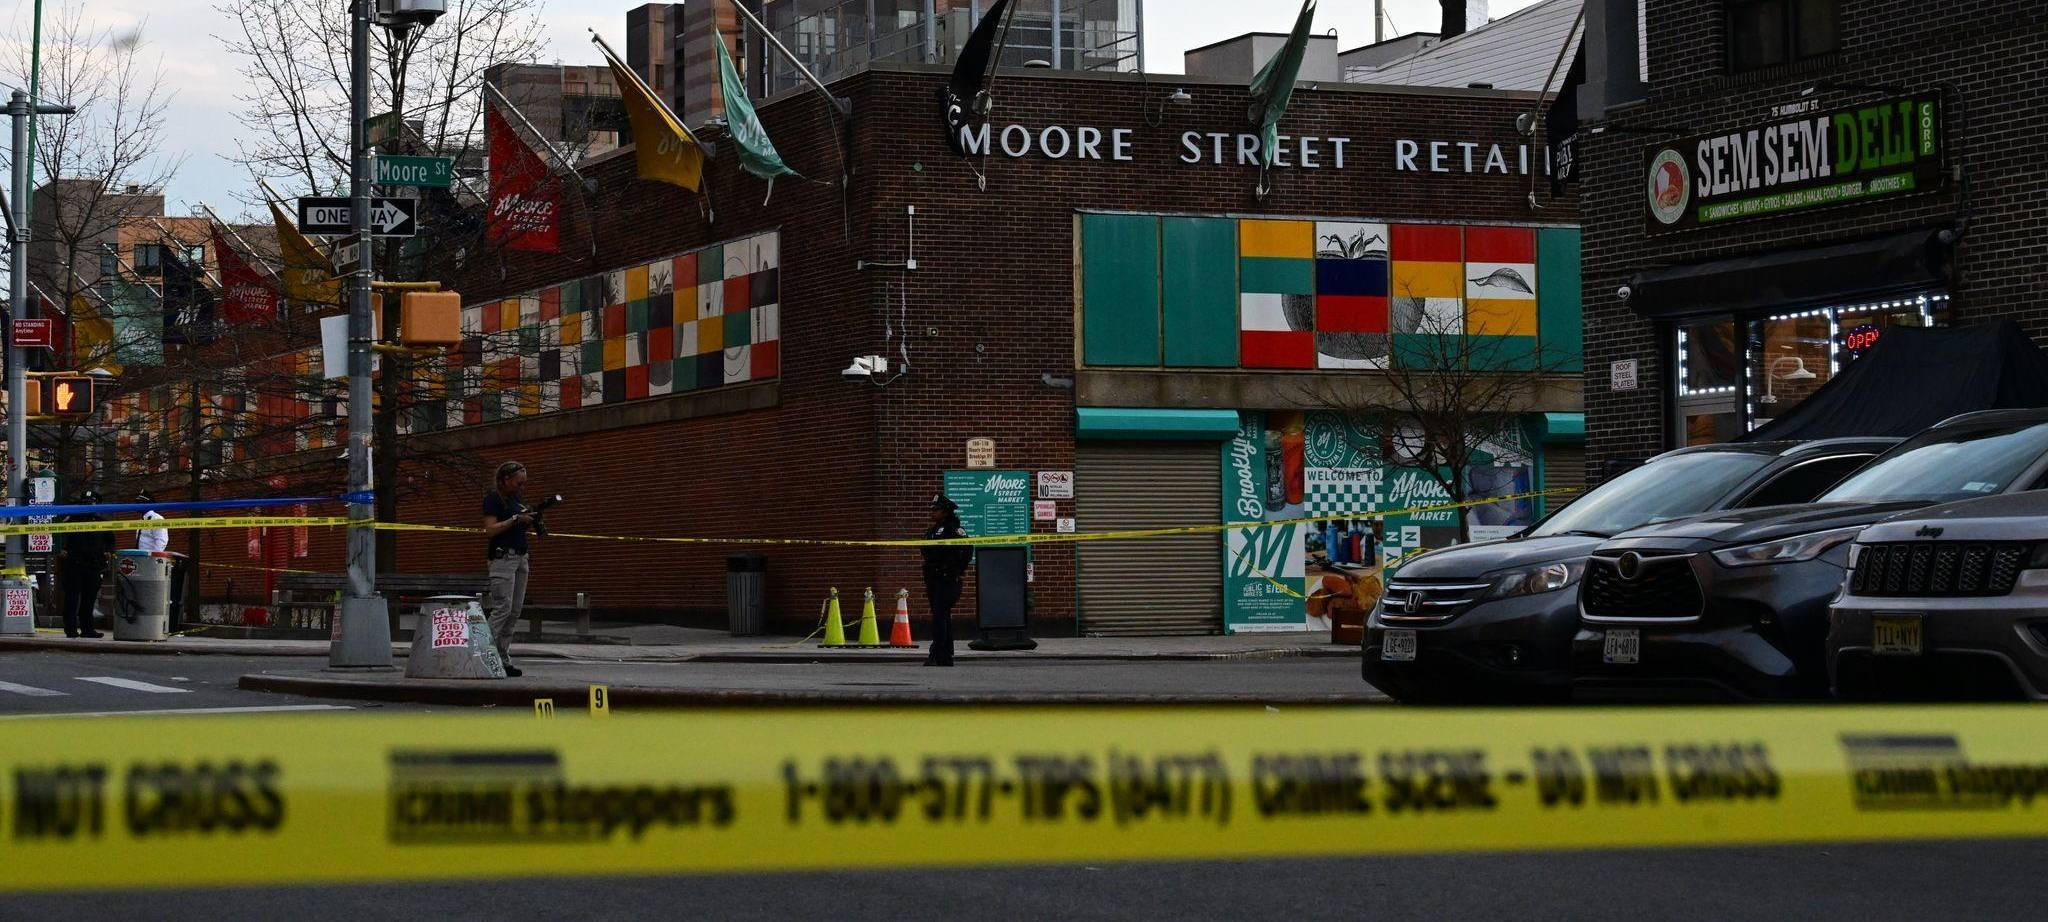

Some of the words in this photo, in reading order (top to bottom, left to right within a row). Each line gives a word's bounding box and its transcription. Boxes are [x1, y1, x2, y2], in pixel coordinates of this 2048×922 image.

[1922, 104, 1933, 153] CORP
[960, 122, 1133, 160] MOORE
[1180, 131, 1350, 168] STREET
[1697, 129, 1760, 198] SEM
[1764, 116, 1831, 186] SEM
[1834, 100, 1916, 175] DELI
[379, 159, 428, 182] Moore
[435, 162, 446, 175] St
[1709, 203, 1740, 218] SANDWICHES
[1785, 192, 1803, 206] SALADS
[1870, 177, 1900, 193] SMOOTHIES
[316, 209, 350, 224] ONE
[1848, 331, 1880, 349] OPEN
[1615, 371, 1632, 379] STEEL
[1616, 363, 1631, 371] ROOF
[1614, 379, 1634, 388] PLATED
[984, 474, 1026, 496] MOORE
[1307, 470, 1362, 481] WELCOME
[1367, 470, 1381, 482] TO
[1040, 484, 1049, 497] NO
[1409, 511, 1453, 520] MARKET
[437, 623, 464, 632] (516)
[595, 688, 604, 709] 9
[1109, 750, 1232, 827] (8477)
[1252, 751, 1370, 818] CRIME
[1376, 748, 1497, 814] SCENE
[1533, 746, 1586, 809] DO
[1586, 744, 1660, 806] NOT
[1661, 741, 1781, 802] CROSS
[13, 765, 106, 839] NOT
[126, 756, 284, 838] CROSS
[526, 782, 736, 841] stoppers
